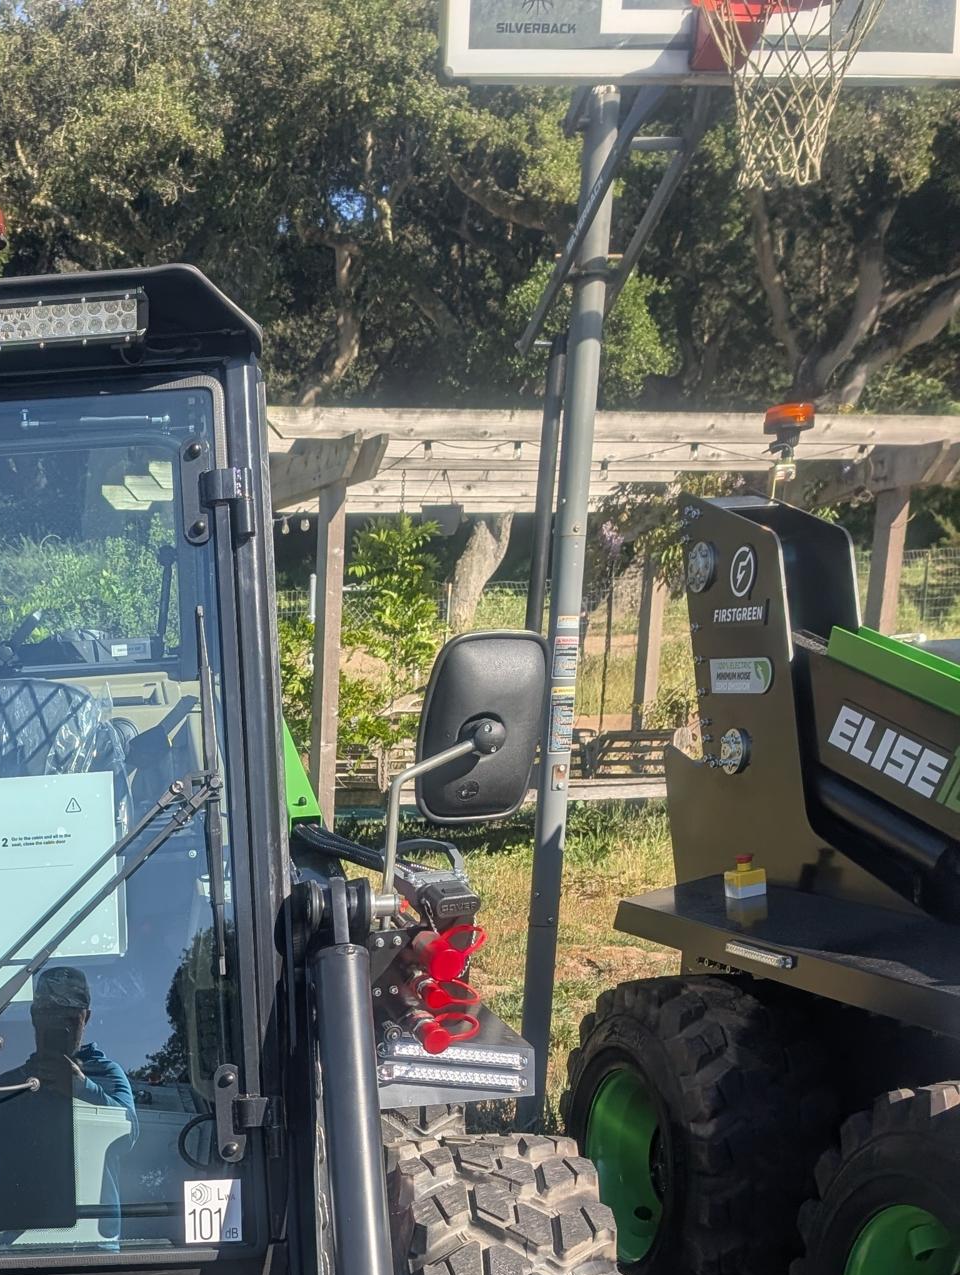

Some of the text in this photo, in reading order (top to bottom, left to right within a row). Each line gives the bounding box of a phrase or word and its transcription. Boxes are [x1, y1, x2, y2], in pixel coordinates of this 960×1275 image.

[496, 22, 577, 34] SILVERBACK
[713, 606, 763, 623] FIRSTGREEN
[827, 705, 949, 799] ELISE
[1, 838, 8, 847] 2
[188, 1207, 239, 1240] 101 dB
